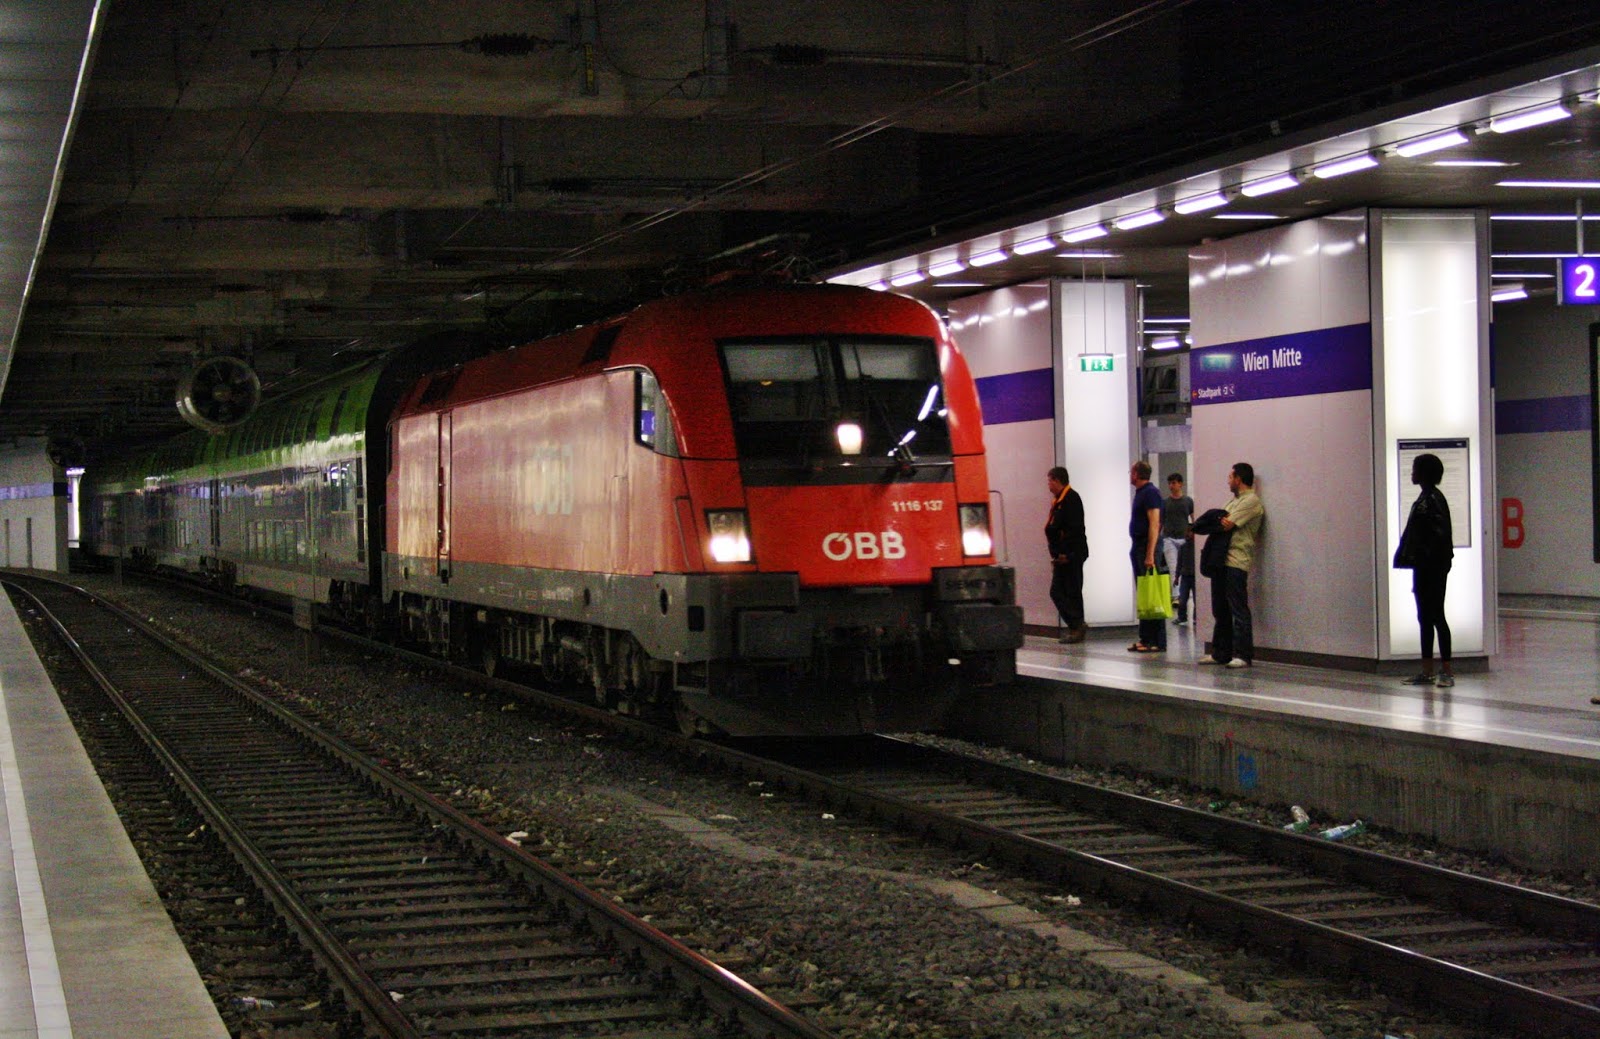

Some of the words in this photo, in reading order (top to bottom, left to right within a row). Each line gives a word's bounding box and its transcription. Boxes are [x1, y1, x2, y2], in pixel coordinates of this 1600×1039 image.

[1575, 264, 1596, 297] 2
[1242, 351, 1269, 371] Wien
[1272, 347, 1302, 369] Mitte
[1198, 386, 1222, 399] Stadtpark
[892, 500, 921, 512] 1116
[923, 500, 943, 511] 137
[1502, 497, 1525, 549] B
[822, 531, 906, 561] ÖBB
